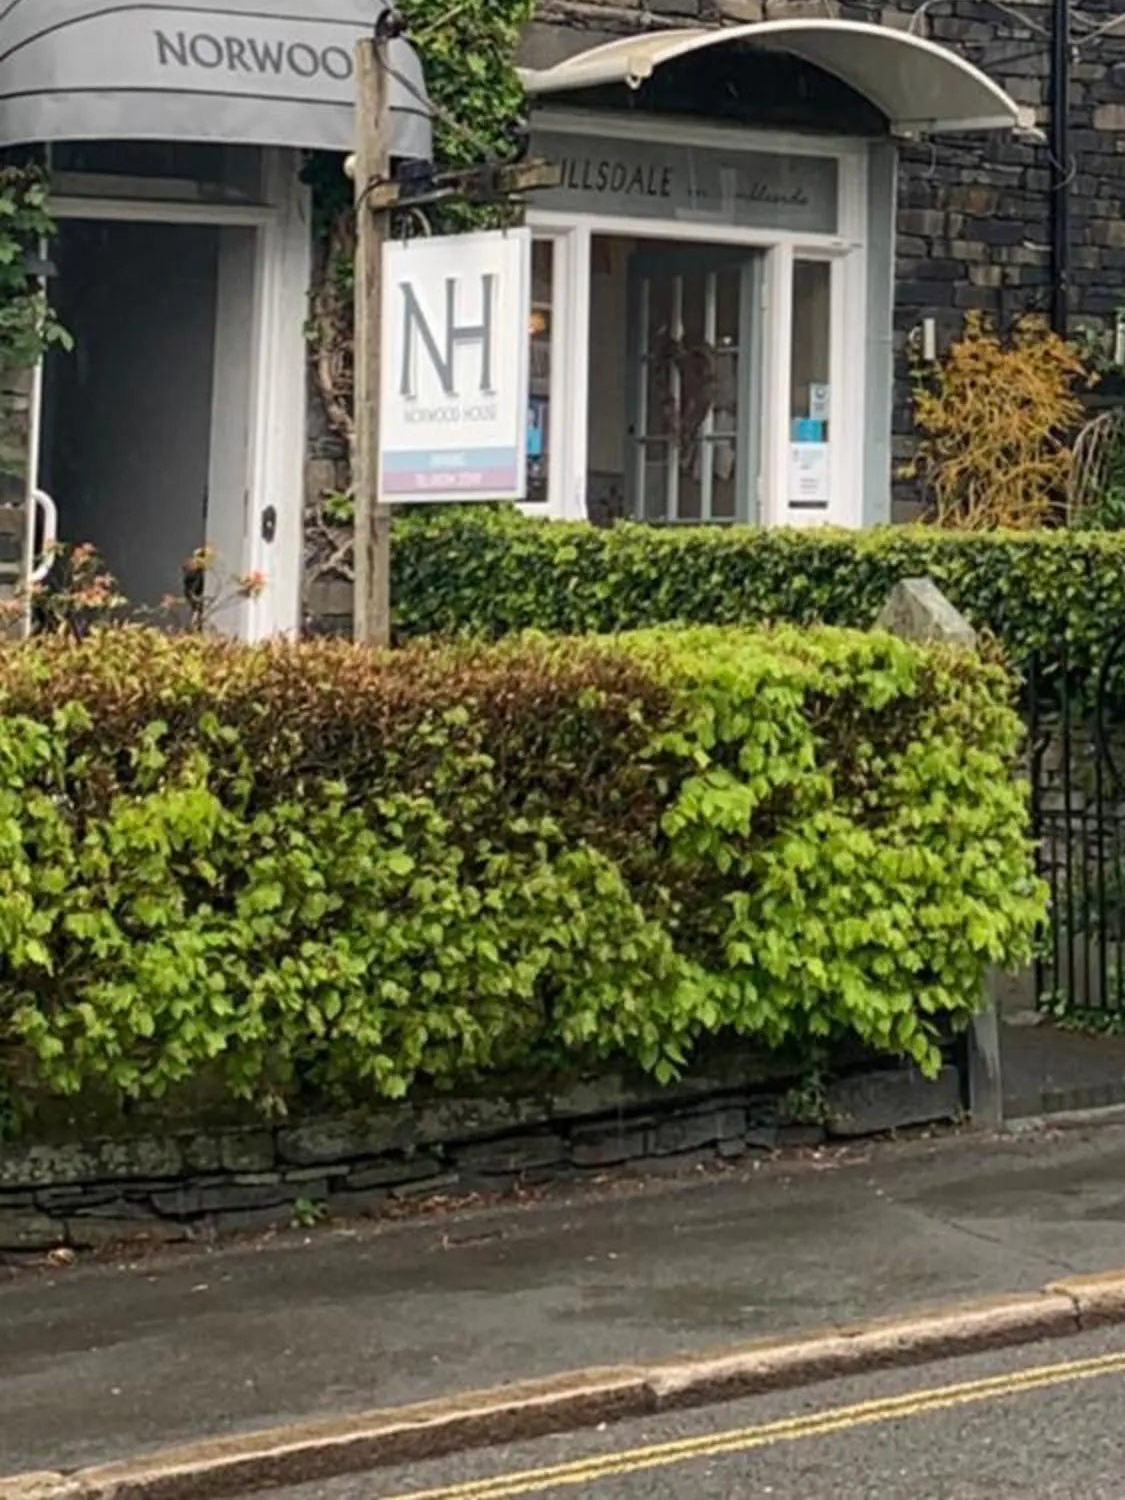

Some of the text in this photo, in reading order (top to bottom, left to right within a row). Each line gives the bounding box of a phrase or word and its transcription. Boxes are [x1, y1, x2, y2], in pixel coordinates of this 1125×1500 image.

[154, 29, 354, 81] NORWOO
[559, 157, 672, 198] ILLSDALE
[399, 273, 494, 400] NH
